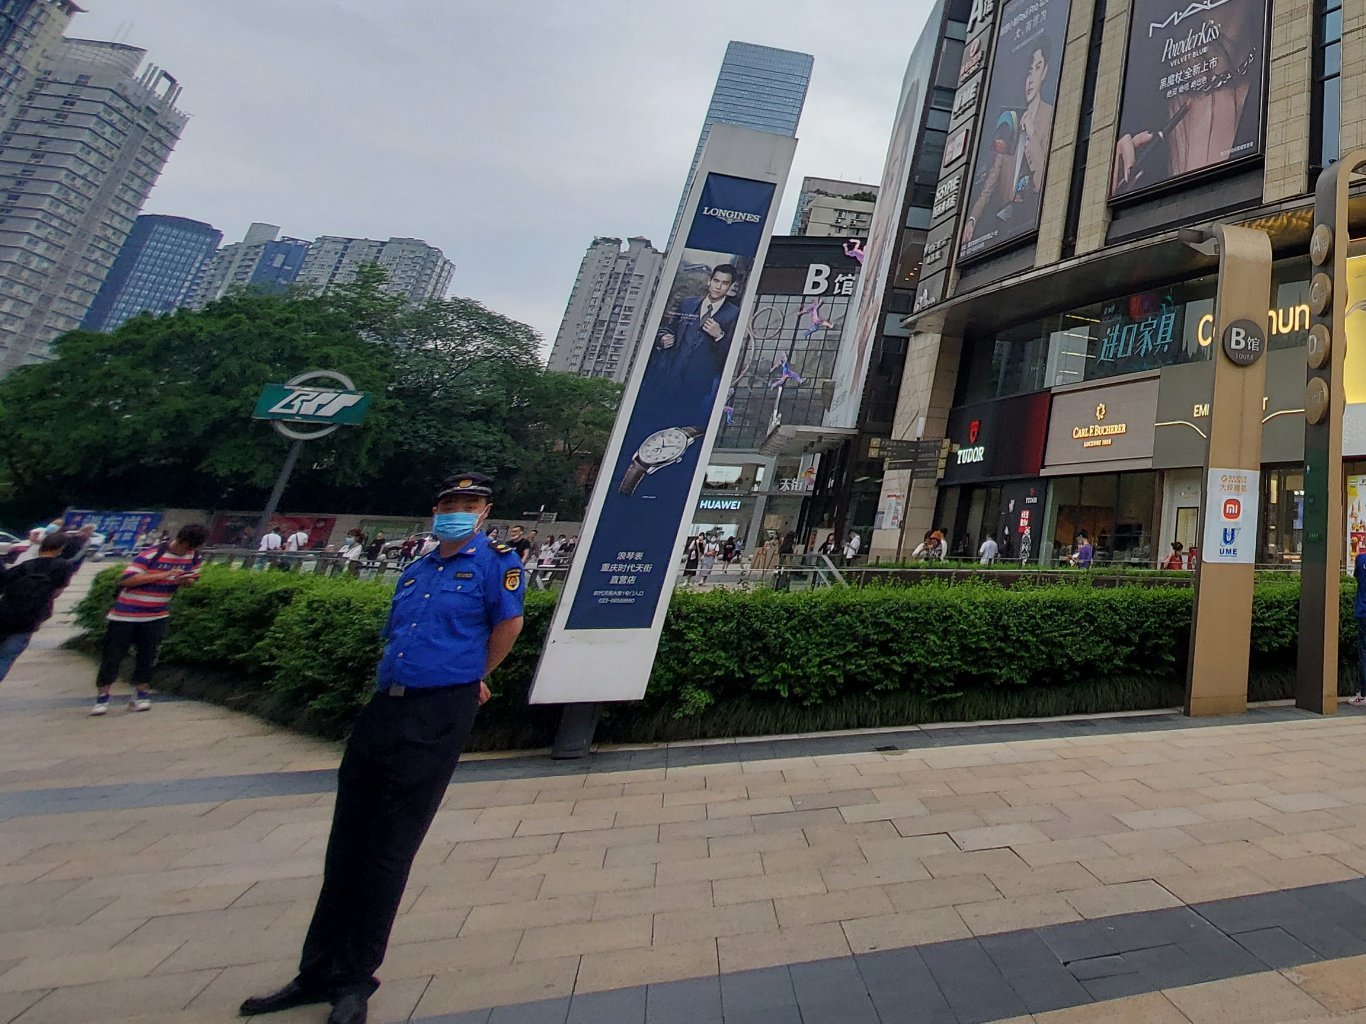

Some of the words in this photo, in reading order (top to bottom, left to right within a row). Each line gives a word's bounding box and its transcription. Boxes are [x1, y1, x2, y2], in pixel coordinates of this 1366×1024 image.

[702, 206, 761, 223] LONGINES
[803, 263, 856, 295] B馆
[1097, 307, 1176, 364] 进口家具
[1230, 327, 1260, 352] B馆
[957, 446, 985, 464] TUDOR
[699, 500, 742, 510] HUAWEI
[617, 551, 644, 560] 浪琴表
[599, 563, 653, 573] 重庆时代天街
[609, 575, 638, 584] 直营店
